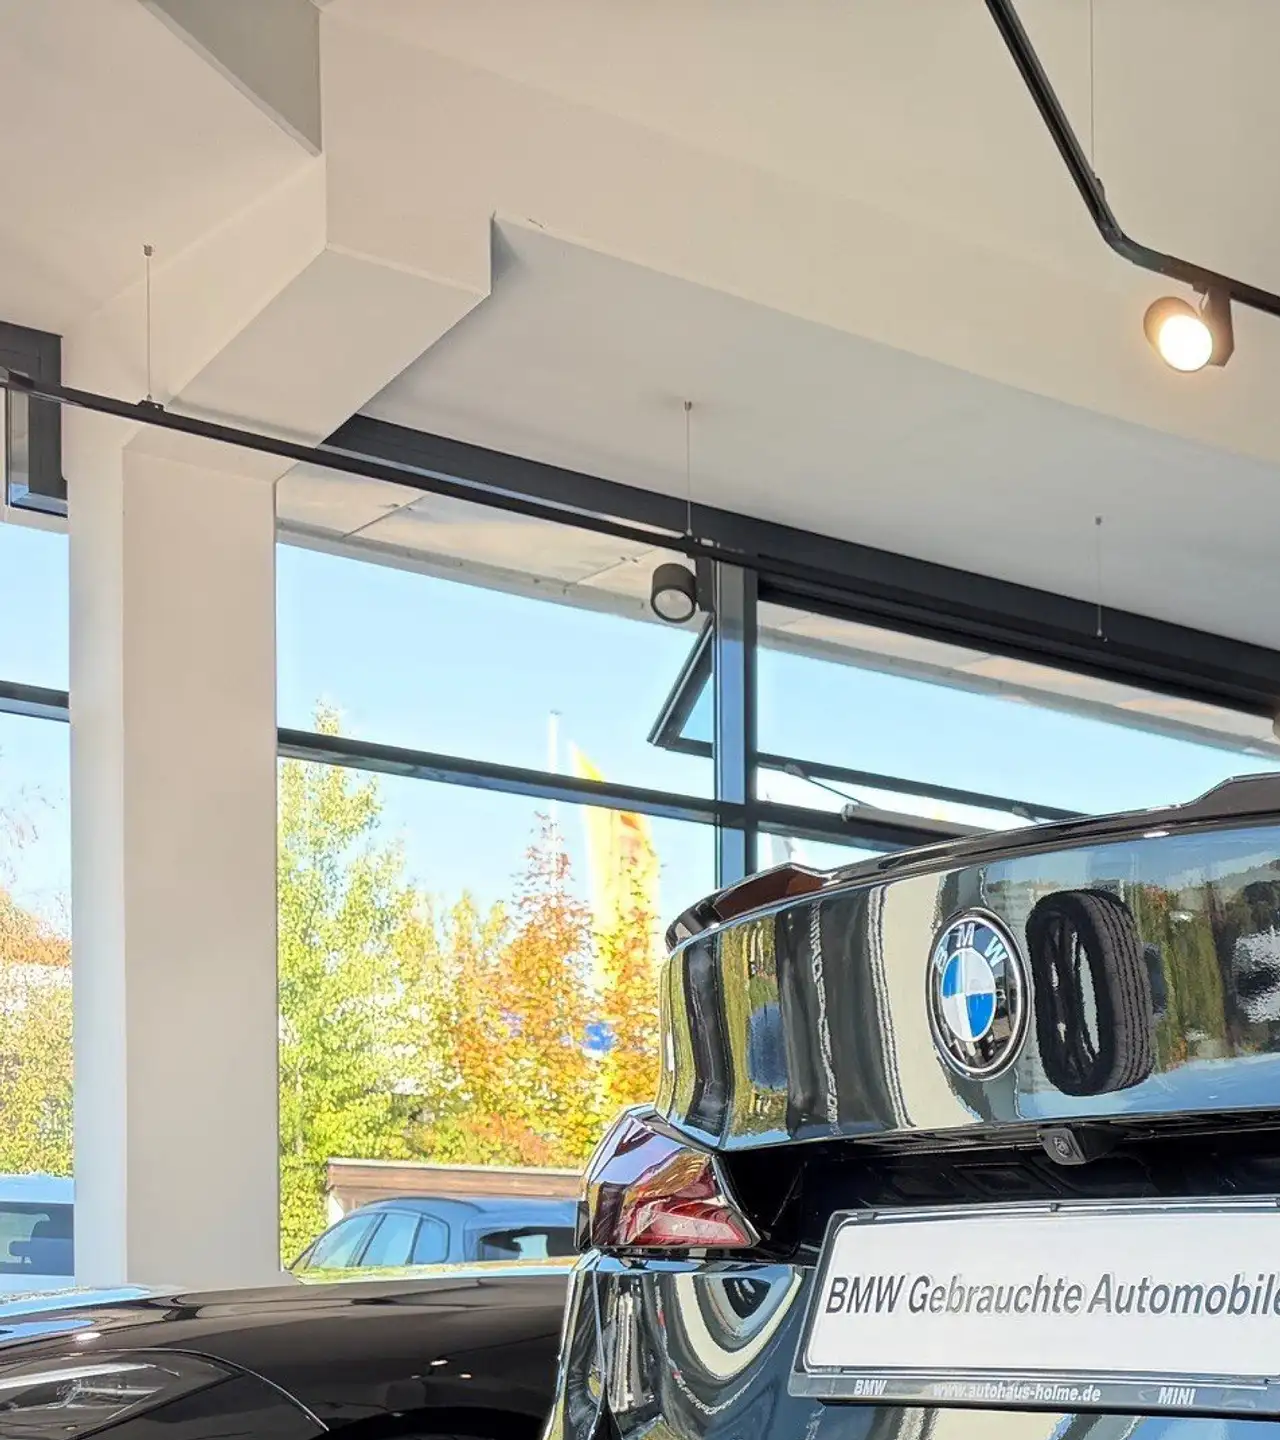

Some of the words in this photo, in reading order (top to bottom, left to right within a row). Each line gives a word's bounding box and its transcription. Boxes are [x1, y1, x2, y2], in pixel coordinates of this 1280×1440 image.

[935, 922, 1009, 974] BMW
[825, 1274, 905, 1314] BMW
[908, 1273, 1083, 1315] Gebrauchte
[853, 1379, 888, 1397] BMW
[932, 1379, 1102, 1403] www.autohaus-holme.de
[1157, 1386, 1196, 1406] MINI
